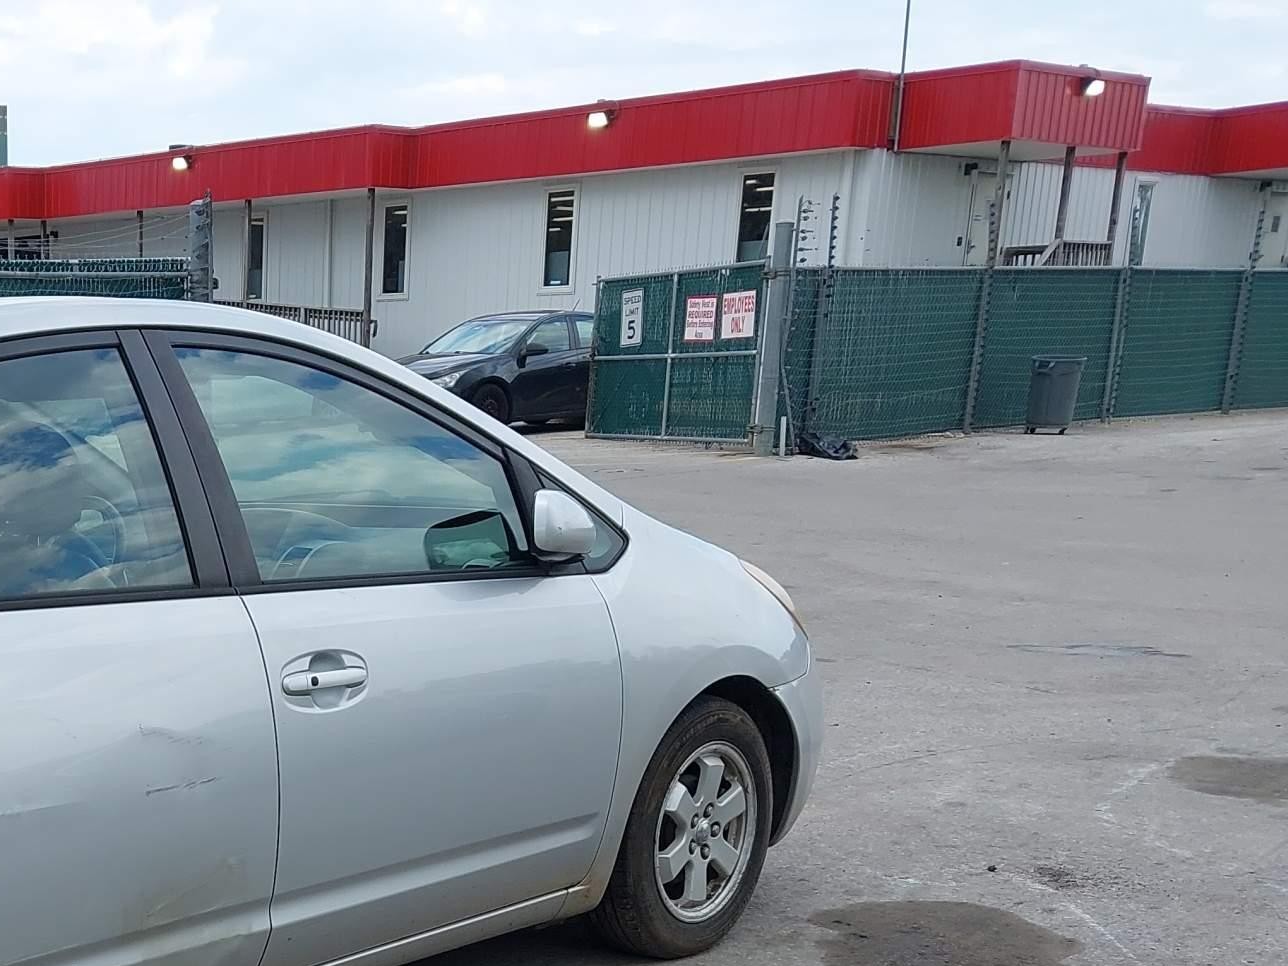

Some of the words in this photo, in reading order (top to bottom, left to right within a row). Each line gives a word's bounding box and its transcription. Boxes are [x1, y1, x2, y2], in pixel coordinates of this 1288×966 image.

[624, 295, 641, 305] SPEED
[724, 295, 755, 314] EMPLOYEES
[625, 307, 639, 317] LIMIT
[688, 310, 714, 319] REQUIRED
[627, 319, 636, 340] 5
[731, 315, 746, 333] ONLY
